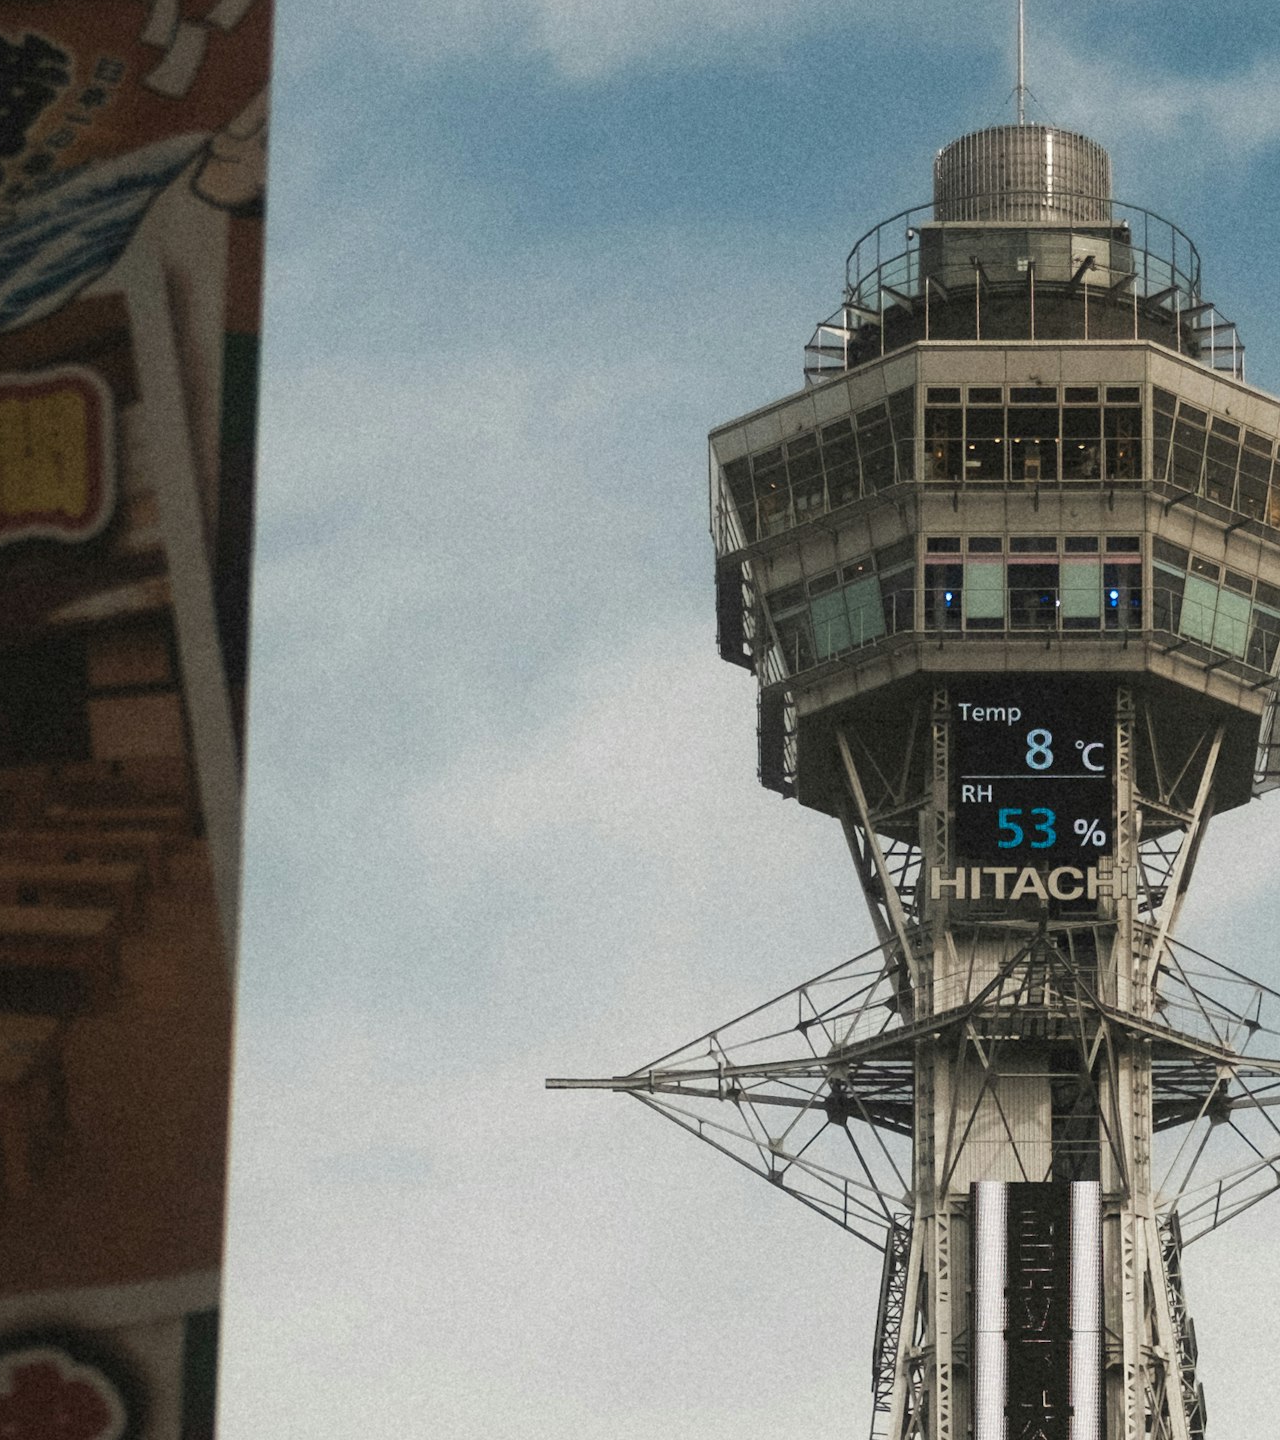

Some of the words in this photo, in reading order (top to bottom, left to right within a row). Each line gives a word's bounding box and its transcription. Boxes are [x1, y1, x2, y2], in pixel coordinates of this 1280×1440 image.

[958, 701, 1022, 728] Temp
[1025, 729, 1055, 770] 8
[960, 784, 995, 804] RH
[996, 808, 1057, 850] 53
[1072, 816, 1108, 848] %
[930, 866, 1139, 901] HITACHI
